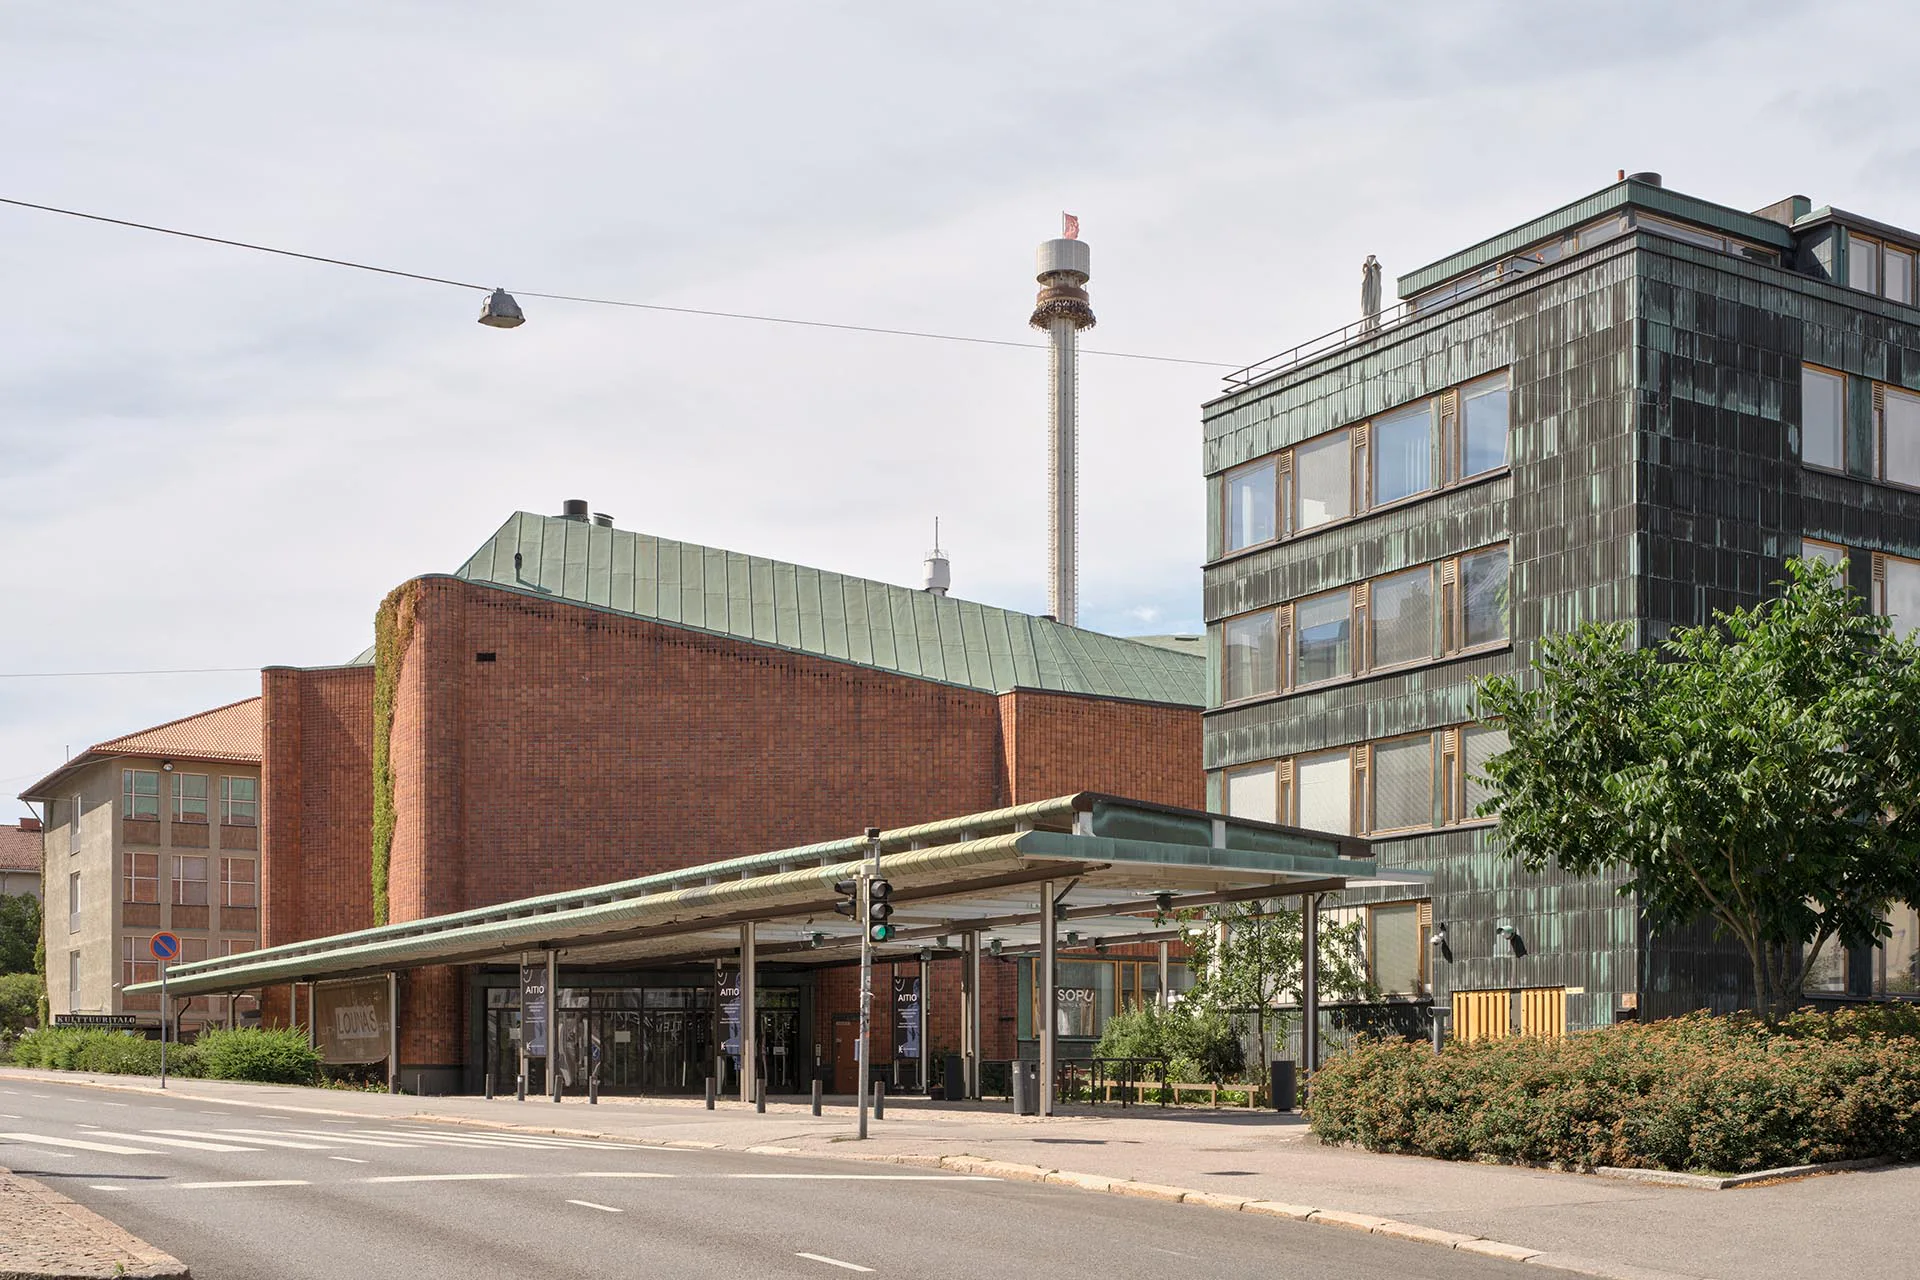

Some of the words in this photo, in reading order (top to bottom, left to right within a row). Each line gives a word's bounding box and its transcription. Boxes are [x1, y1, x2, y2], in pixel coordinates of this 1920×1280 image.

[525, 986, 545, 994] AITIO
[720, 988, 740, 996] AITIO
[898, 994, 917, 1002] AITIO
[1057, 989, 1094, 1002] SOPU
[57, 1016, 135, 1024] KULTTUURITALO
[337, 1010, 377, 1034] LOUNAS
